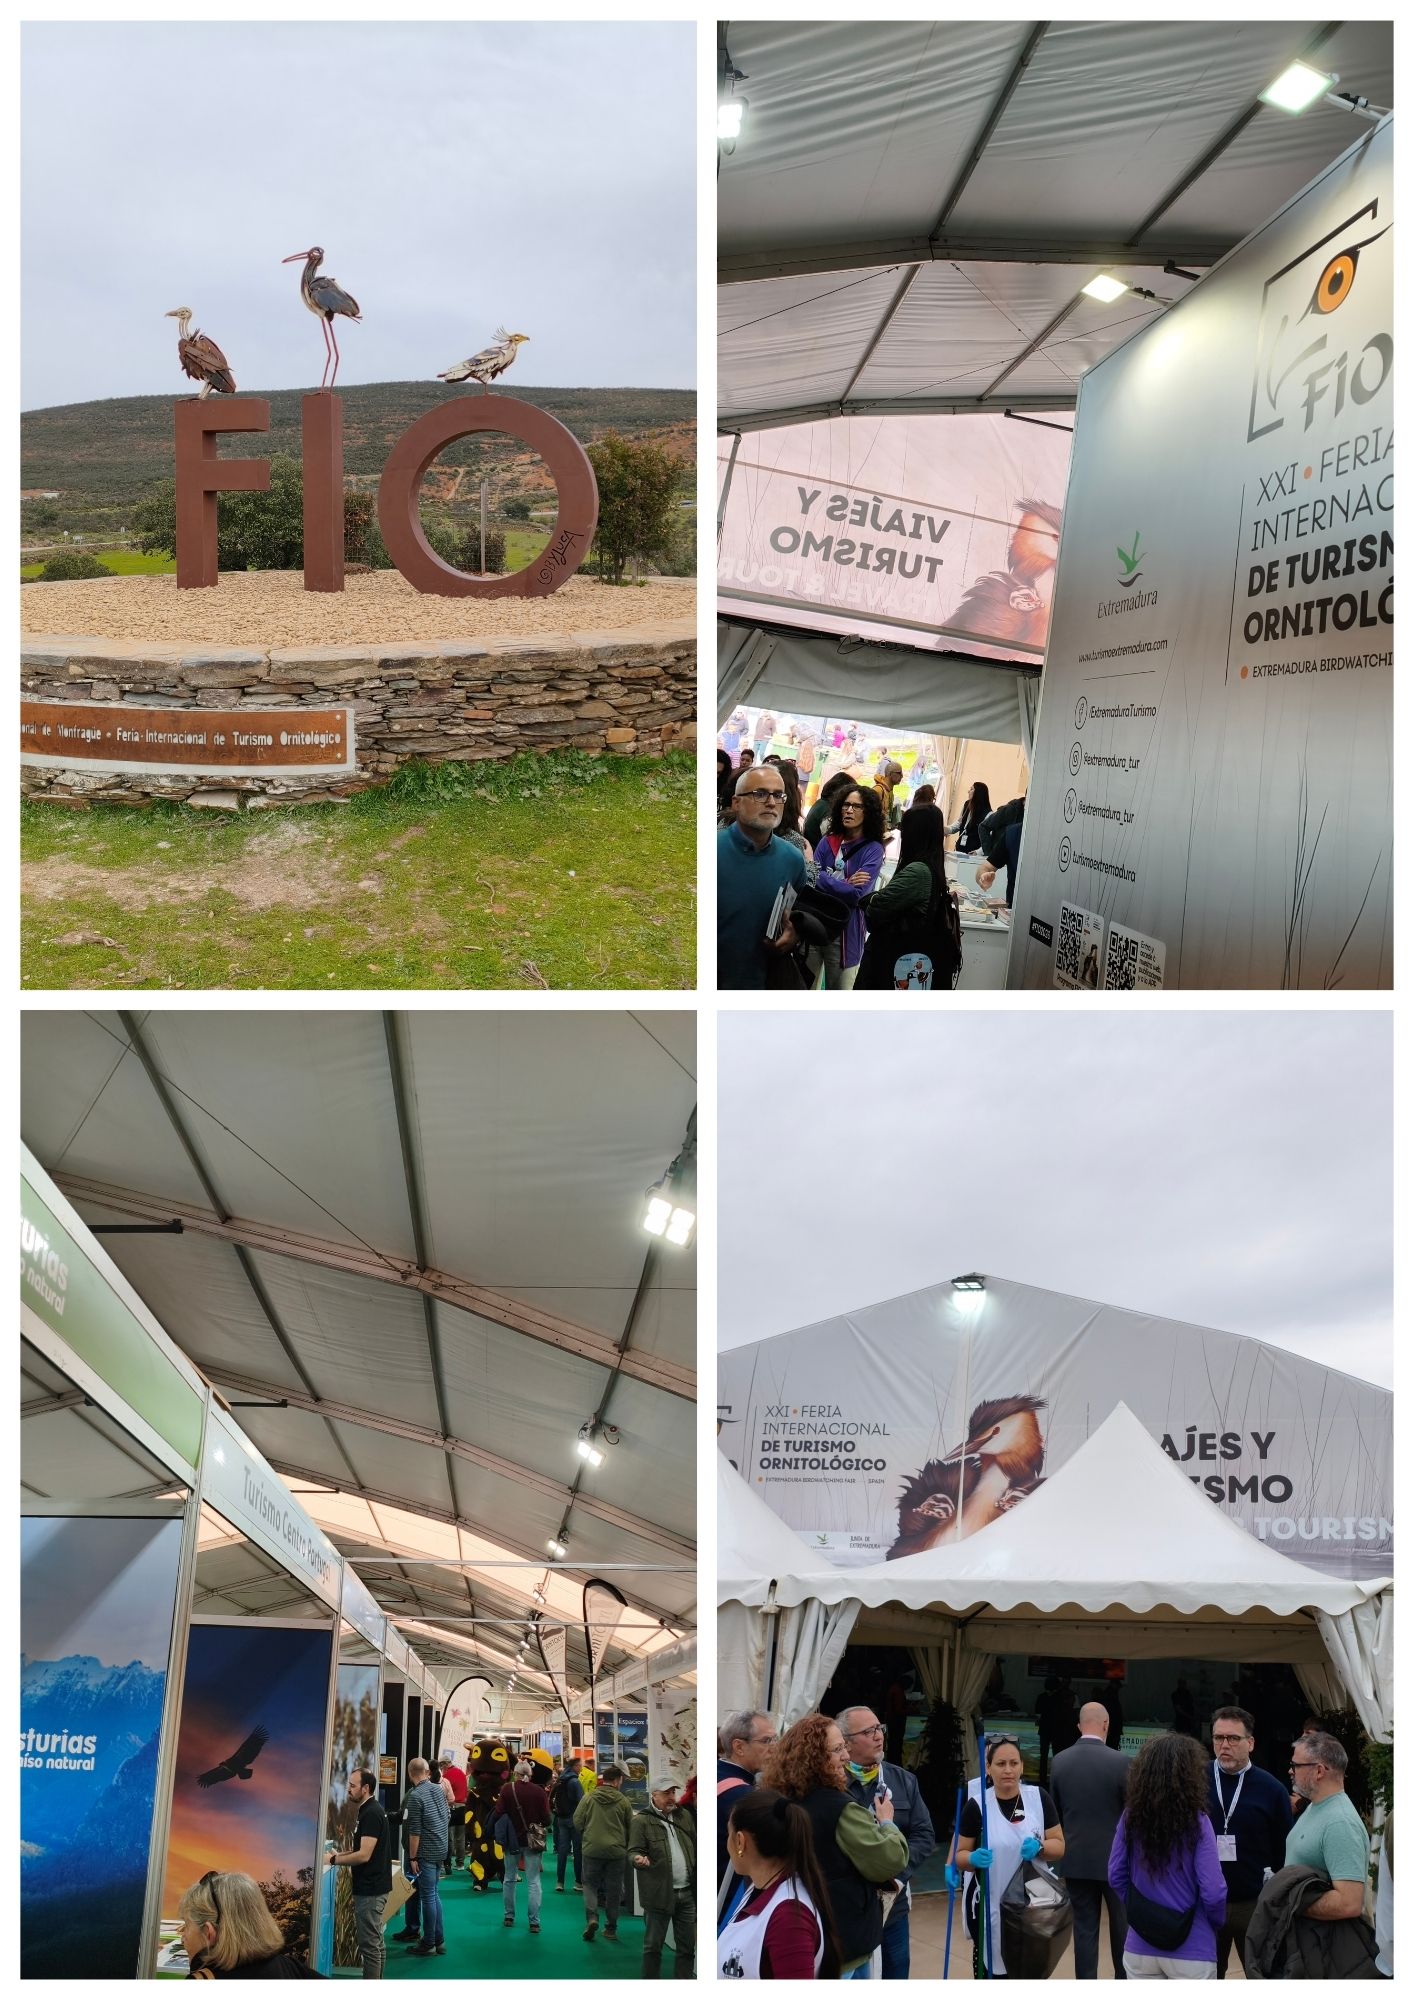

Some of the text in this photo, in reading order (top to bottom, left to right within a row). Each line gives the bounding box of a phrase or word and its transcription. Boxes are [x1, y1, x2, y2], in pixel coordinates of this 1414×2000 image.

[1300, 332, 1394, 434] FIO
[174, 393, 599, 600] FIO
[1257, 462, 1299, 507] XXI
[1247, 560, 1280, 598] DE
[1097, 590, 1158, 619] Extremadura
[1252, 651, 1393, 678] EXTREMADURA BIRDWATCHI
[42, 723, 52, 736] de
[116, 727, 140, 743] Feria
[145, 729, 207, 745] Internacional
[213, 732, 226, 746] de
[232, 731, 273, 746] Turismo
[280, 730, 341, 748] Ornitológico
[20, 1218, 69, 1291] urias
[27, 1267, 65, 1317] natural
[764, 1405, 842, 1418] XXI FERIA
[762, 1422, 891, 1436] INTERNACIONAL
[761, 1440, 856, 1453] DE TURISMO
[1250, 1431, 1276, 1460] Y
[759, 1454, 887, 1472] ORNITOLÓGICO
[242, 1465, 281, 1532] Turismo
[282, 1511, 306, 1556] Centro
[46, 1756, 95, 1771] natural
